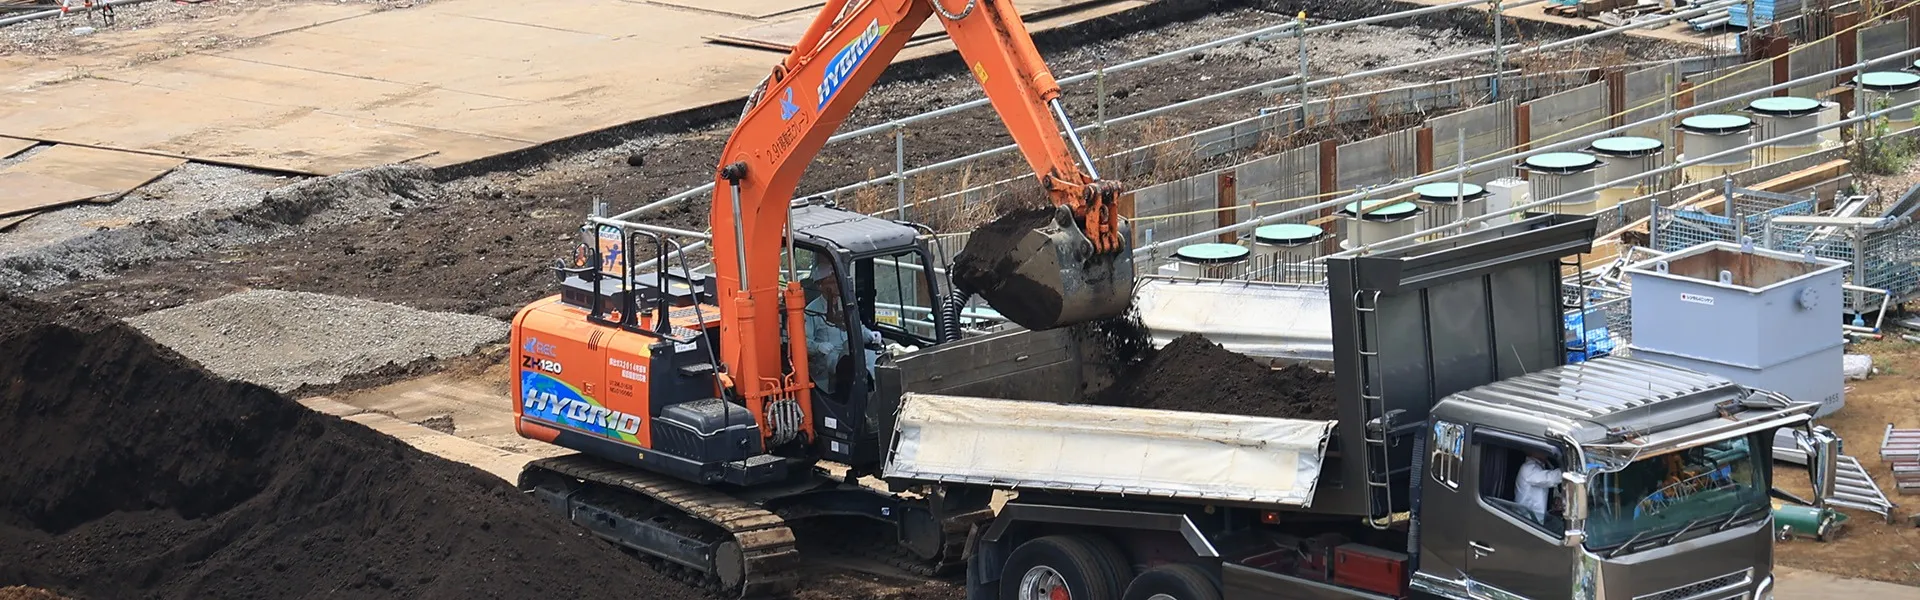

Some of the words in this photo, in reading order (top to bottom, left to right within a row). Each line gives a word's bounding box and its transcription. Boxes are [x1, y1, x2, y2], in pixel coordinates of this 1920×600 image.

[816, 17, 879, 105] HYBRID
[522, 354, 562, 375] ZH120
[524, 388, 642, 436] HYBRID
